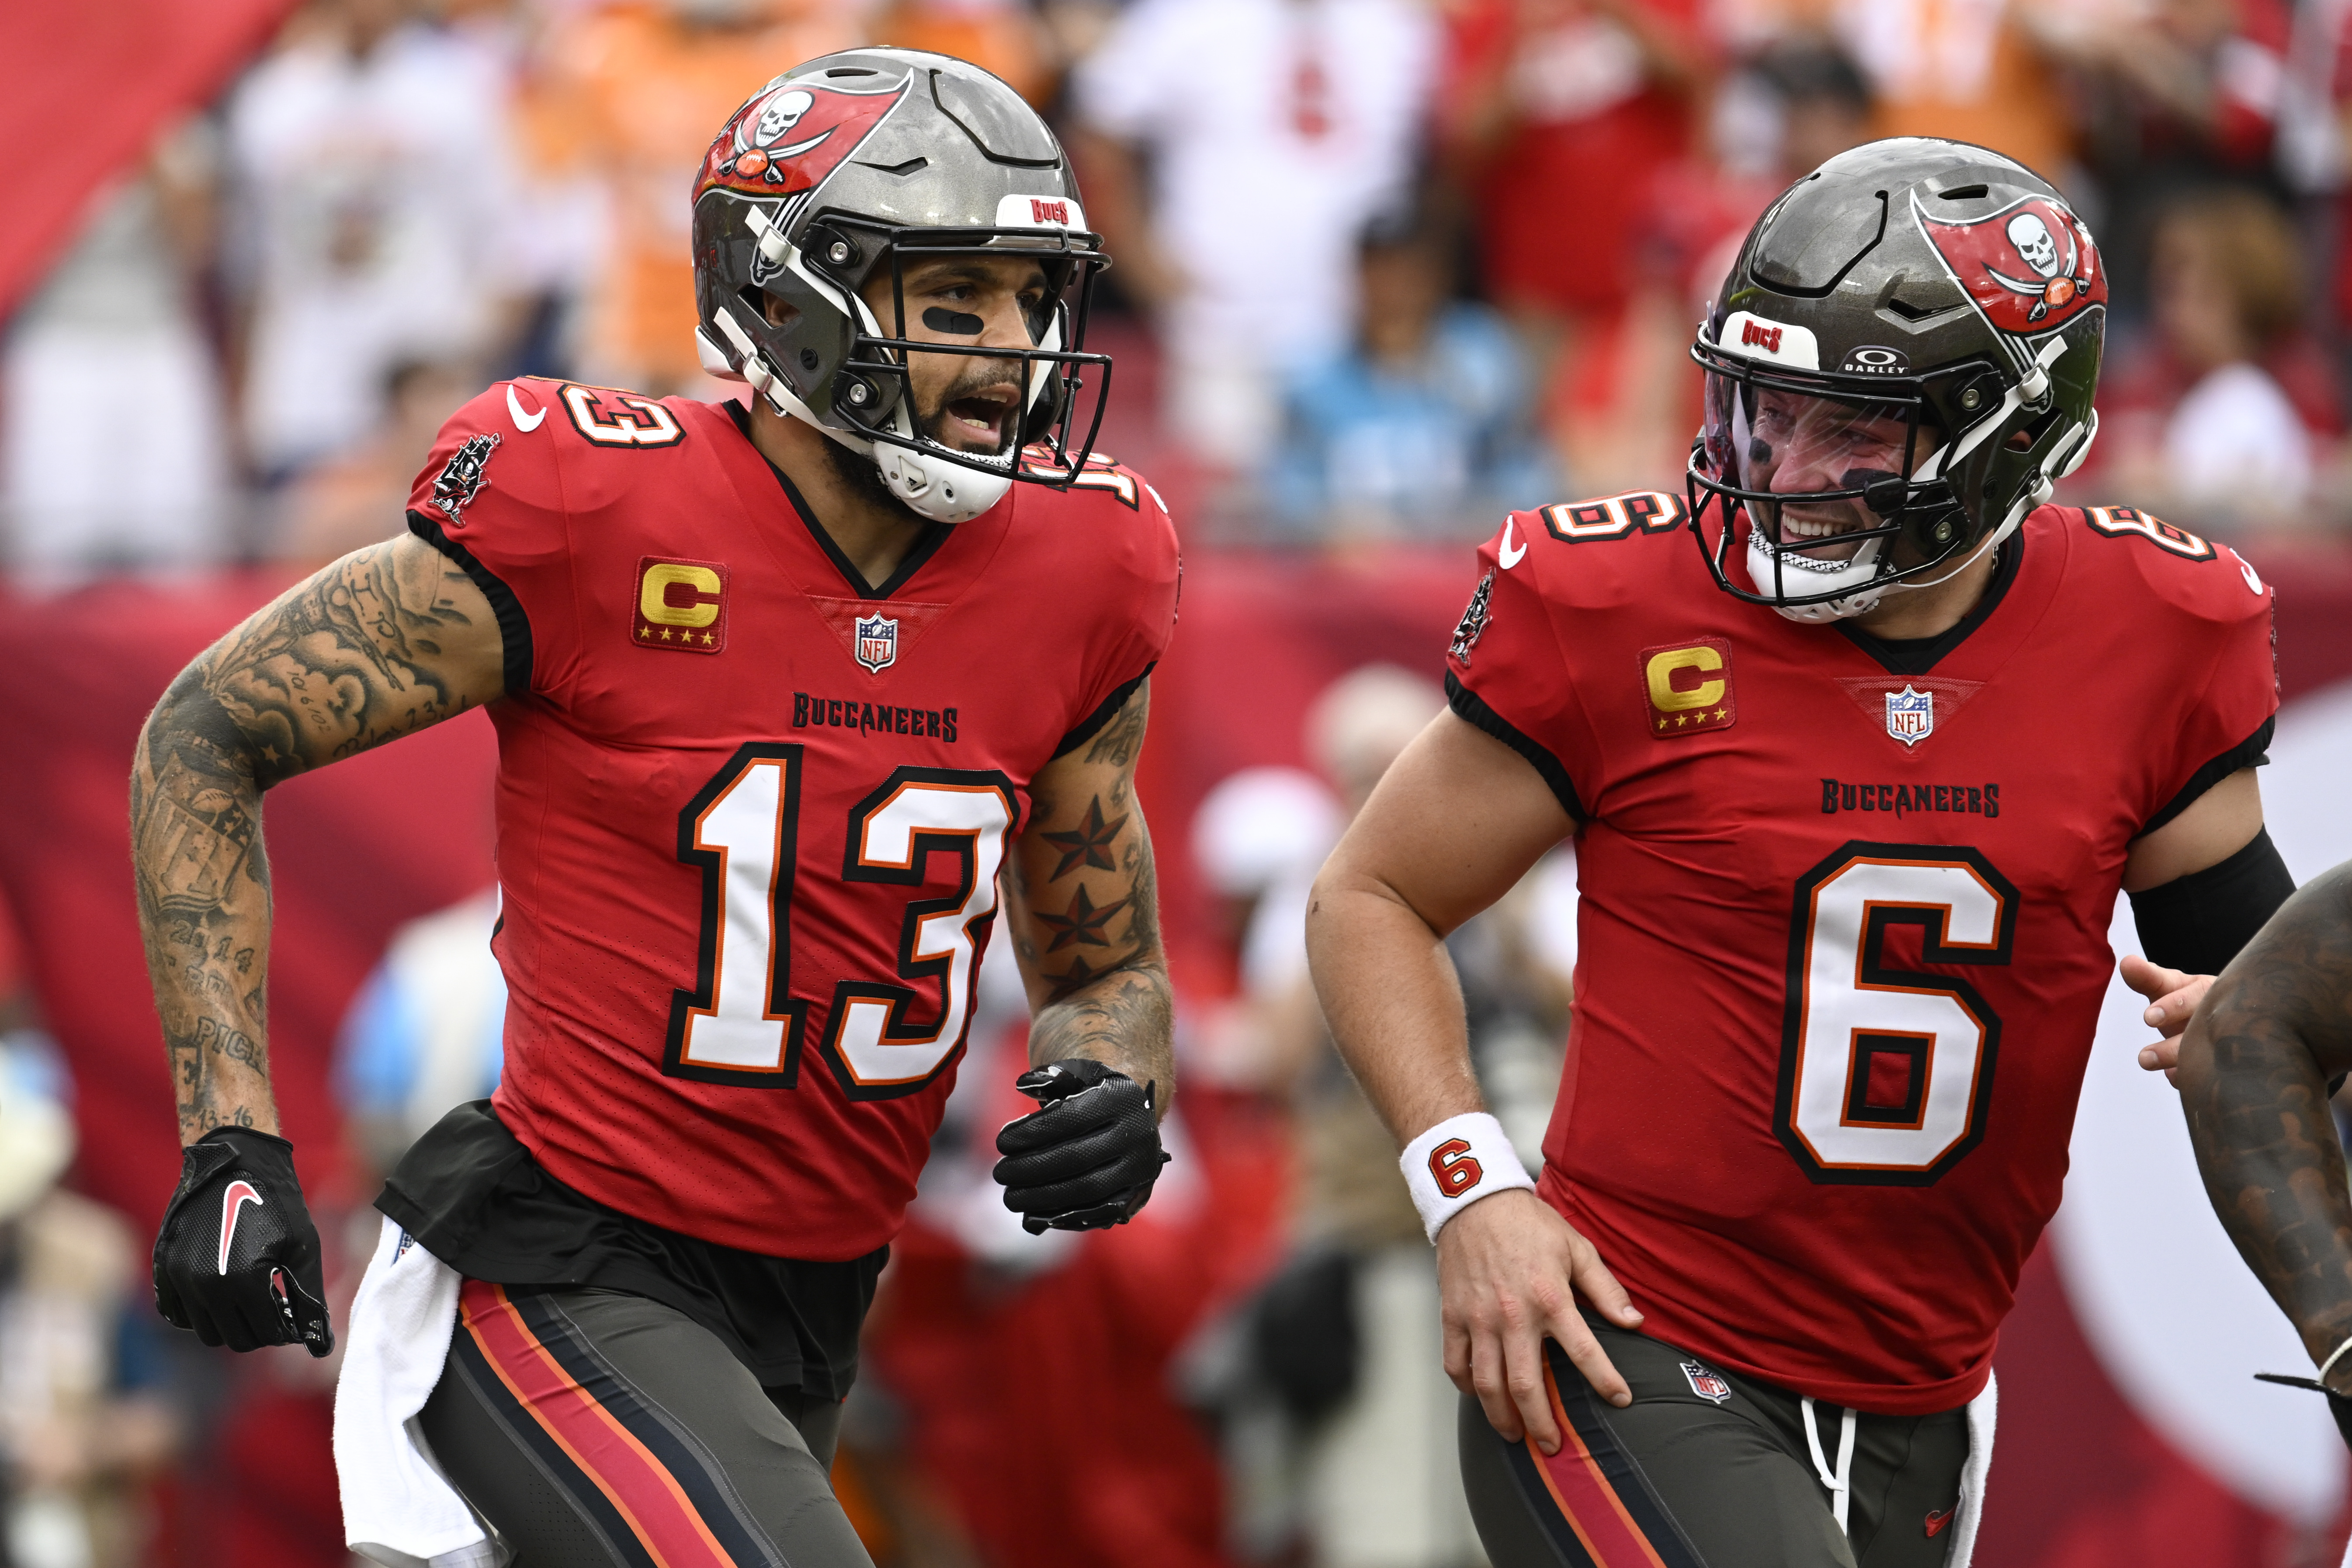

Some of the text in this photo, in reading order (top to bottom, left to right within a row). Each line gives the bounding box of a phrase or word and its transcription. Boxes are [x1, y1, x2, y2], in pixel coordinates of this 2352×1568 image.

[1030, 199, 1069, 225] BUCS
[1741, 319, 1783, 353] BUCS
[1845, 364, 1906, 374] OAKLEY
[519, 375, 687, 449] 3
[1539, 489, 1689, 544] 6
[640, 563, 721, 628] C
[862, 639, 890, 662] NFL
[1646, 646, 1725, 712] C
[792, 691, 957, 743] BUCCANEERS
[1894, 712, 1925, 735] NFL
[1820, 778, 1999, 820] BUCCANEERS
[662, 741, 1021, 1102] 13
[1772, 840, 2021, 1186] 6
[1428, 1138, 1484, 1198] 6
[1694, 1377, 1725, 1395] NFL
